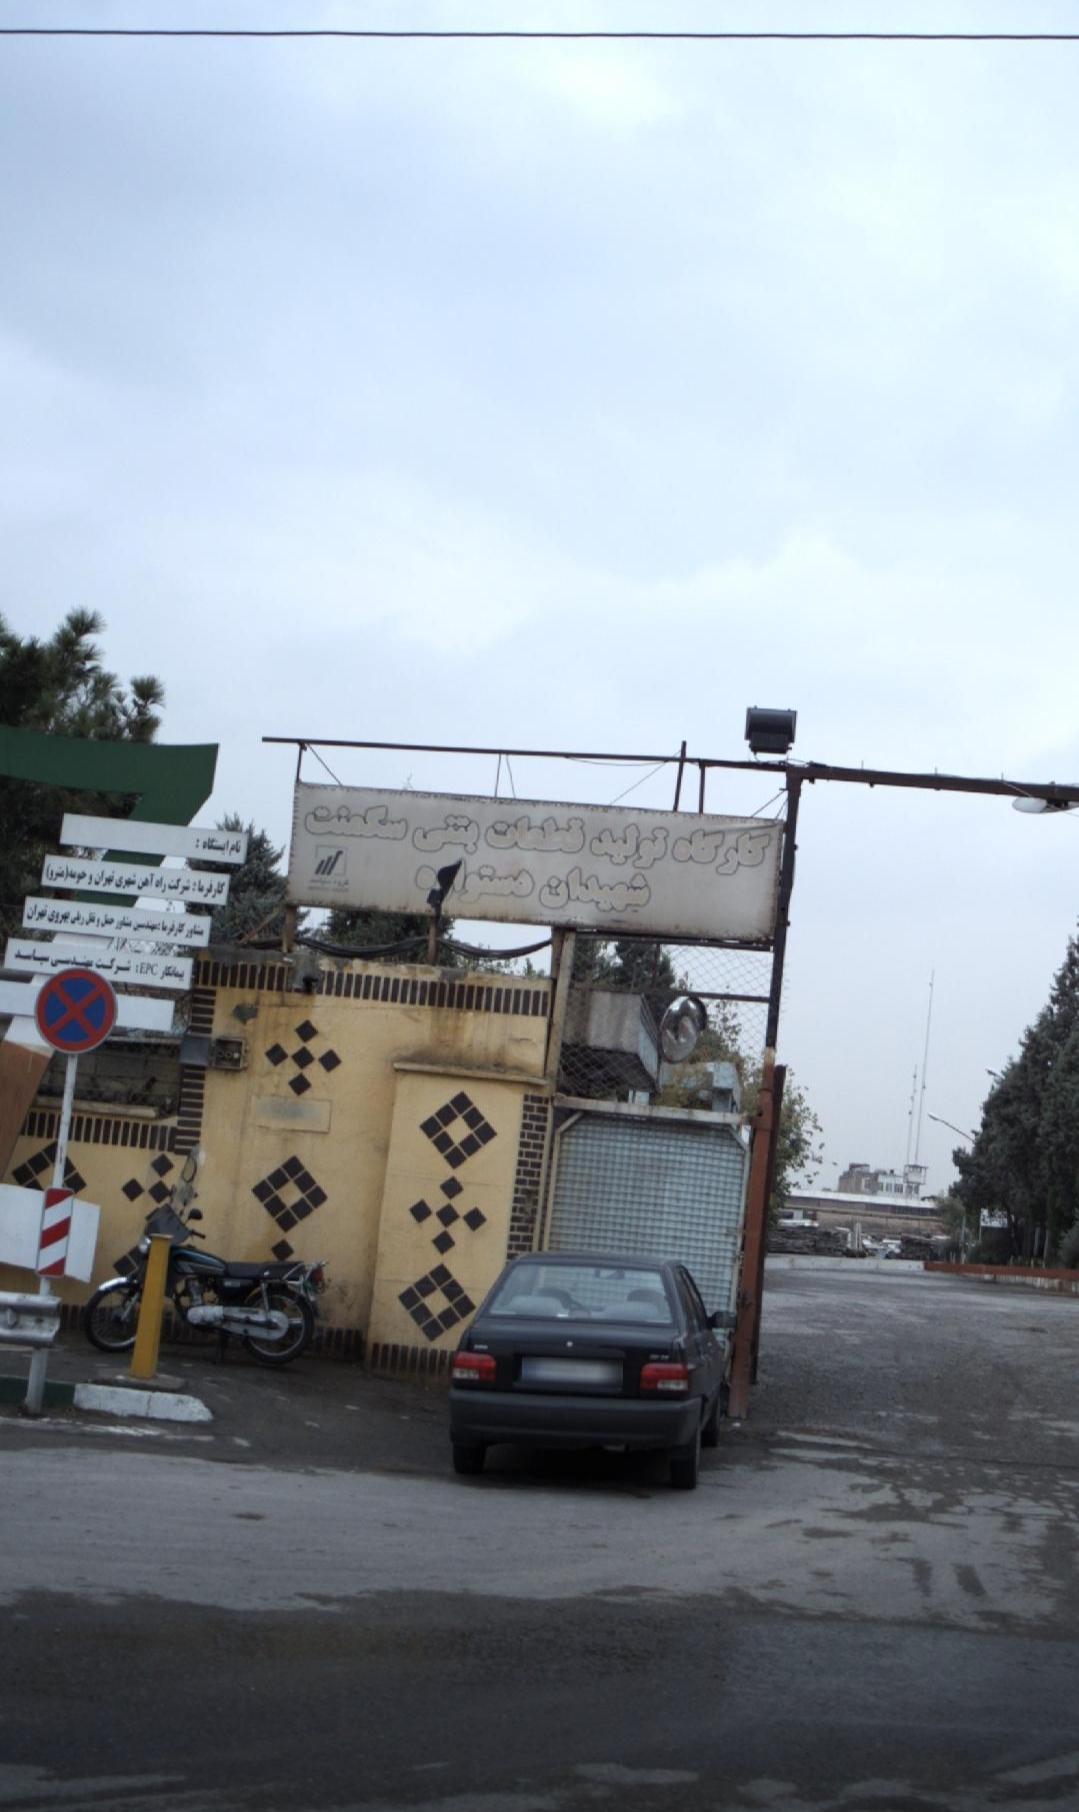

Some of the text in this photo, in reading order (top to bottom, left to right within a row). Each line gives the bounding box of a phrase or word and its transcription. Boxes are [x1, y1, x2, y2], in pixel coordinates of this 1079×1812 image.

[412, 814, 480, 854] بتنی
[484, 816, 586, 853] قطعات
[229, 840, 241, 856] نام
[591, 824, 668, 868] تولید
[94, 870, 114, 887] تهران
[114, 874, 136, 889] شهری
[168, 878, 190, 895] شرکت
[539, 866, 652, 913] شهیدان
[50, 955, 93, 968] مهندسی
[95, 957, 132, 975] شرکت
